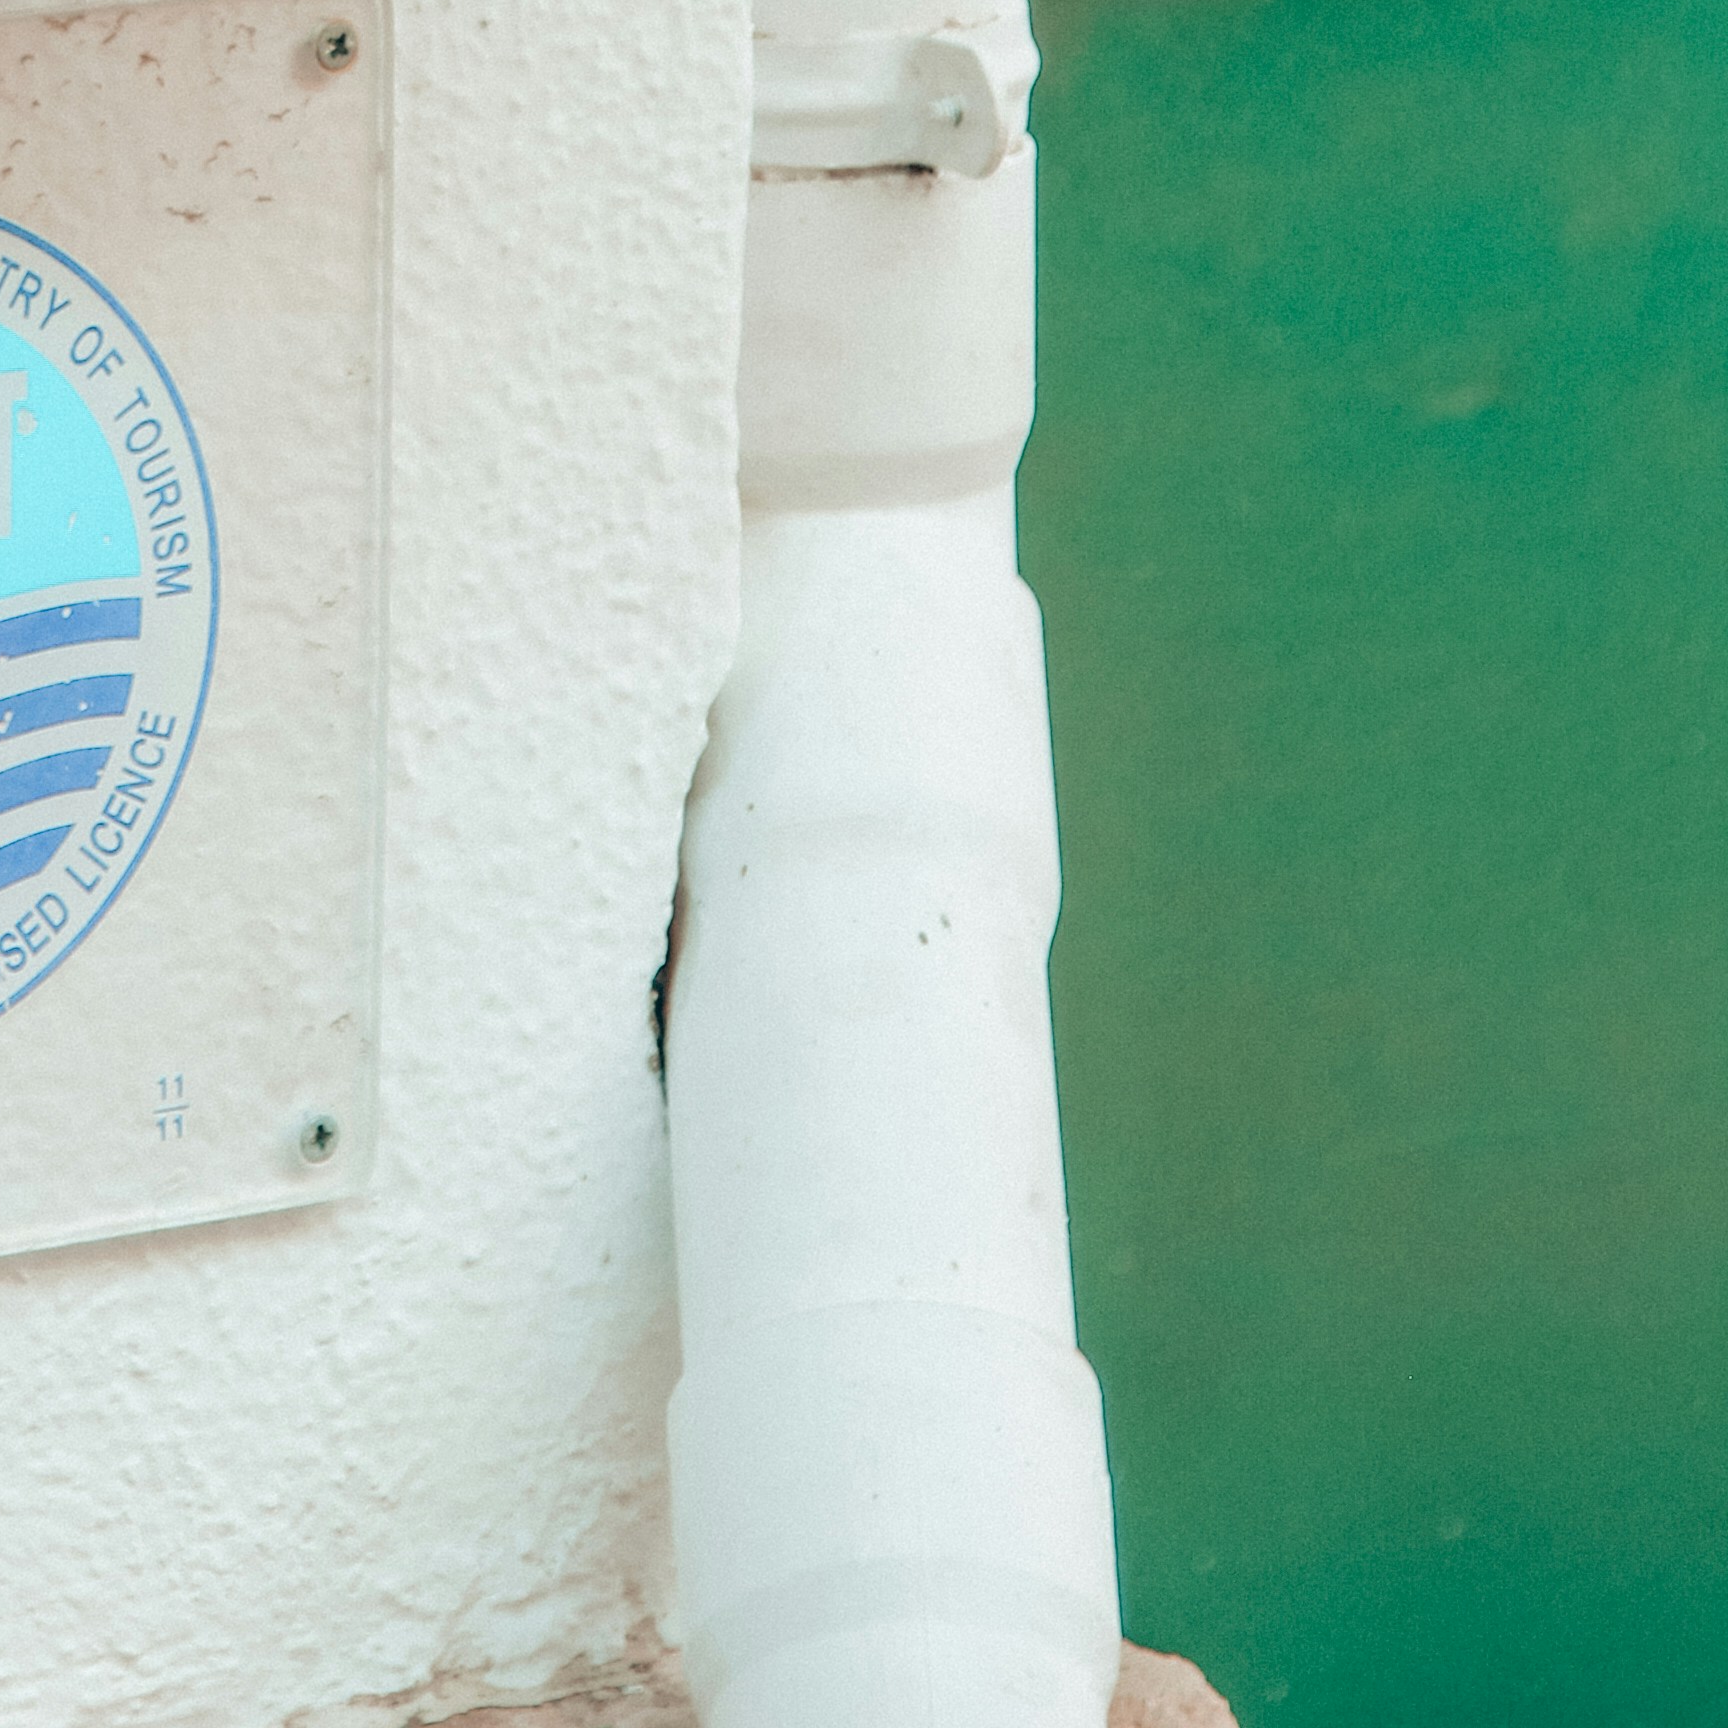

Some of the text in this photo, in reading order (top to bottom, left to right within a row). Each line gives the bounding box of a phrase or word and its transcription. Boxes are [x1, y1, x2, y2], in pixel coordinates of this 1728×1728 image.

[70, 325, 125, 379] OF
[113, 387, 193, 599] TOURISM
[64, 710, 177, 894] LICENCE
